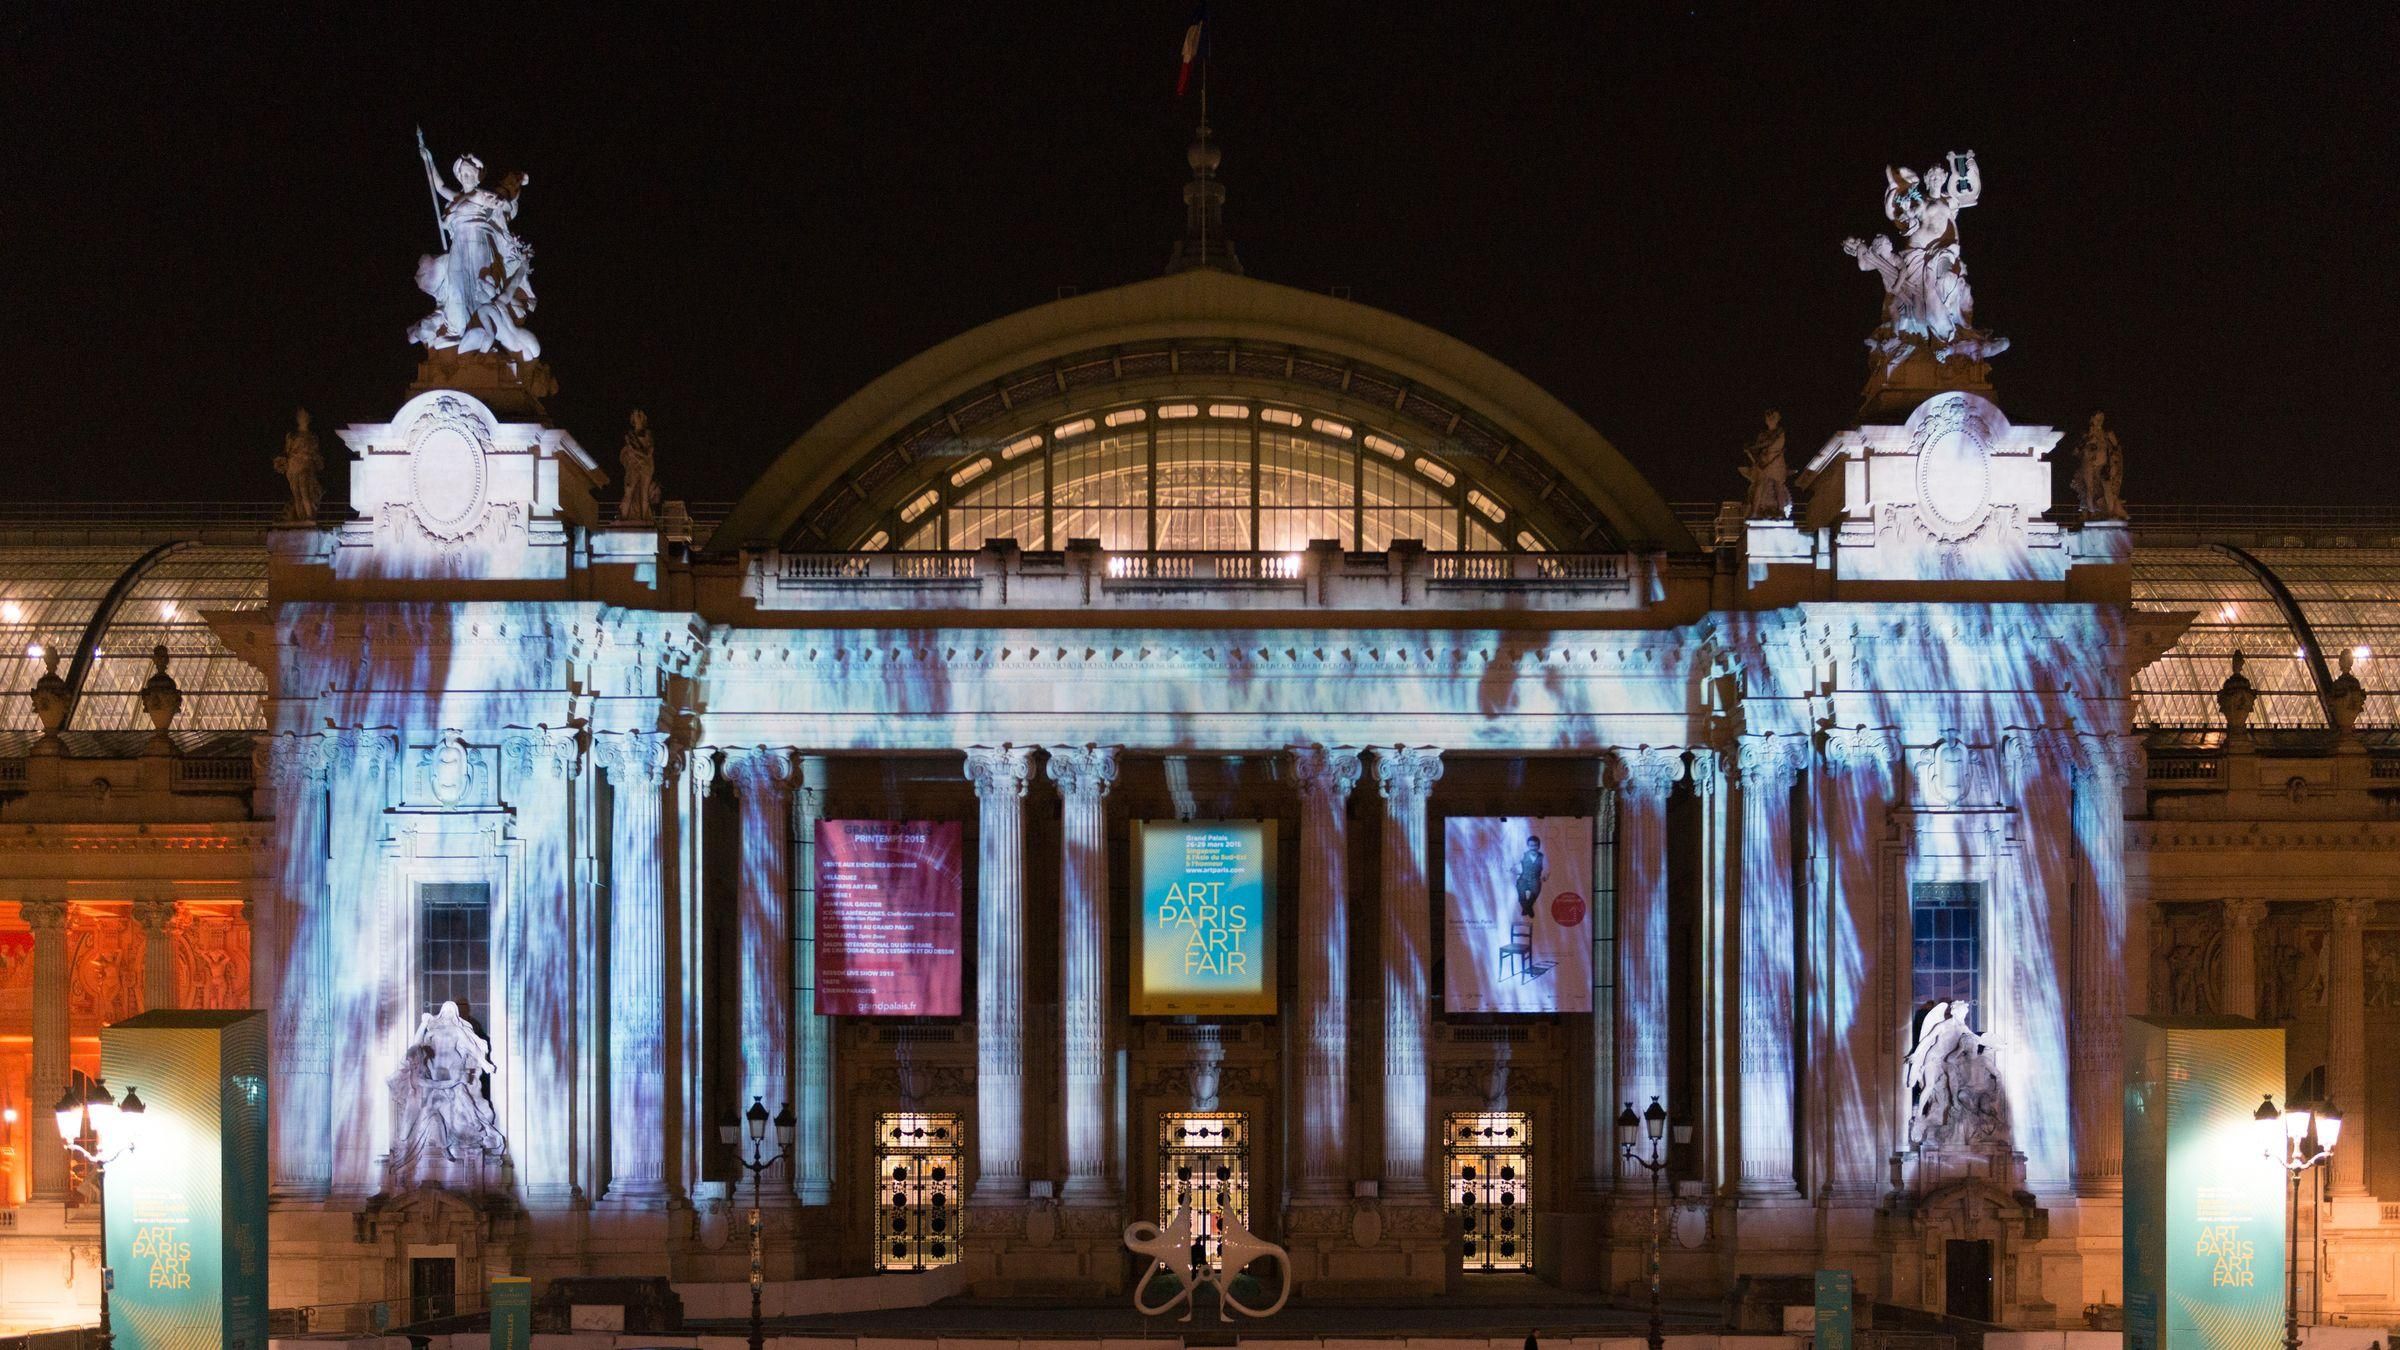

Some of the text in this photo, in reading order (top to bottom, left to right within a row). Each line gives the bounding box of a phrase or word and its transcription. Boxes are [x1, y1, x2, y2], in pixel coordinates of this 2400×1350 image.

[844, 825, 886, 834] GRAND
[854, 834, 926, 843] PRINTEMPS 2015
[1163, 882, 1224, 906] ART
[1159, 905, 1247, 929] PARIS
[1185, 928, 1247, 952] ART
[1185, 952, 1247, 975] FAIR
[858, 1001, 917, 1012] grandpalais.fr
[136, 1226, 177, 1242] ART
[2199, 1225, 2241, 1242] ART
[132, 1241, 191, 1259] PARIS
[2196, 1240, 2255, 1257] PARIS
[150, 1257, 191, 1274] ART
[2214, 1256, 2254, 1272] ART
[149, 1273, 191, 1289] FAIR
[2213, 1271, 2254, 1288] FAIR
